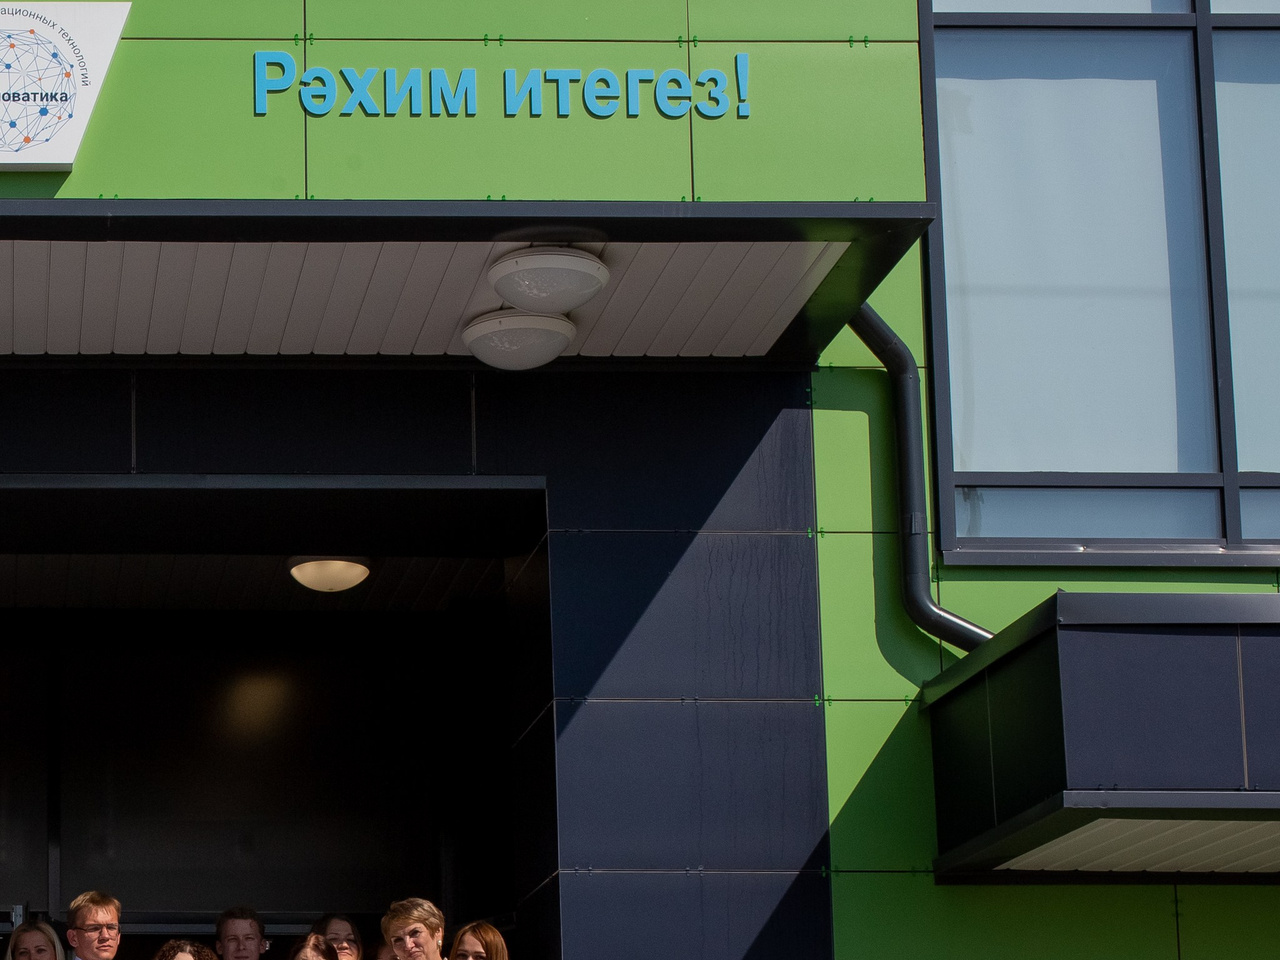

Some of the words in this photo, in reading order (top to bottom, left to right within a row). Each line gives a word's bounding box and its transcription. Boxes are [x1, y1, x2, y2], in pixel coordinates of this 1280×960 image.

[57, 27, 91, 87] технологий
[254, 51, 477, 117] Рәхим
[504, 53, 751, 117] итегез!
